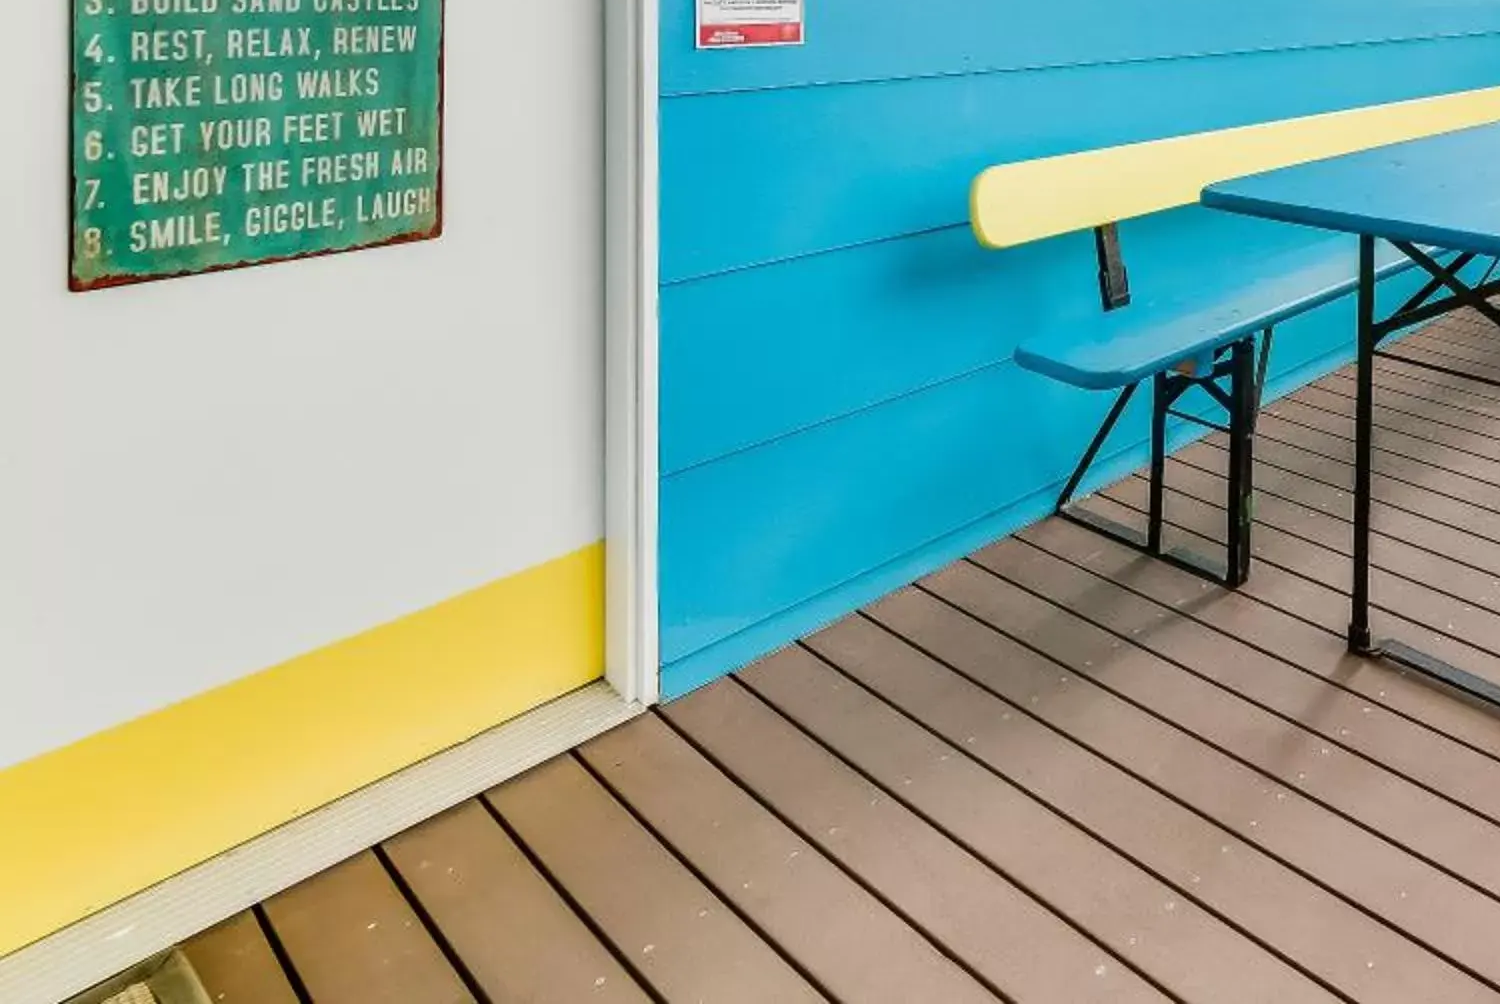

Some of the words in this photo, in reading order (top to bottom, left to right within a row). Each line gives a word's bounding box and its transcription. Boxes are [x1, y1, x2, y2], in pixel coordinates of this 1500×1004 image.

[84, 35, 115, 63] 4.
[132, 30, 213, 65] REST,
[228, 28, 320, 60] RELAX,
[333, 26, 417, 54] RENEW
[84, 82, 113, 112] 5.
[130, 76, 201, 108] TAKE
[215, 74, 283, 104] LONG
[297, 68, 380, 98] WALKS
[84, 132, 114, 160] 6.
[132, 124, 184, 156] GET
[200, 118, 271, 151] YOUR
[284, 112, 344, 143] FEET
[357, 108, 406, 137] WET
[83, 180, 105, 210] 7.
[134, 166, 228, 205] ENJOY
[242, 160, 289, 192] THE
[302, 154, 379, 186] FRESH
[391, 148, 428, 175] AIR
[83, 228, 112, 257] 8.
[130, 212, 230, 253] SMILE,
[246, 198, 345, 237] GIGGLE,
[357, 188, 431, 223] LAUGH
